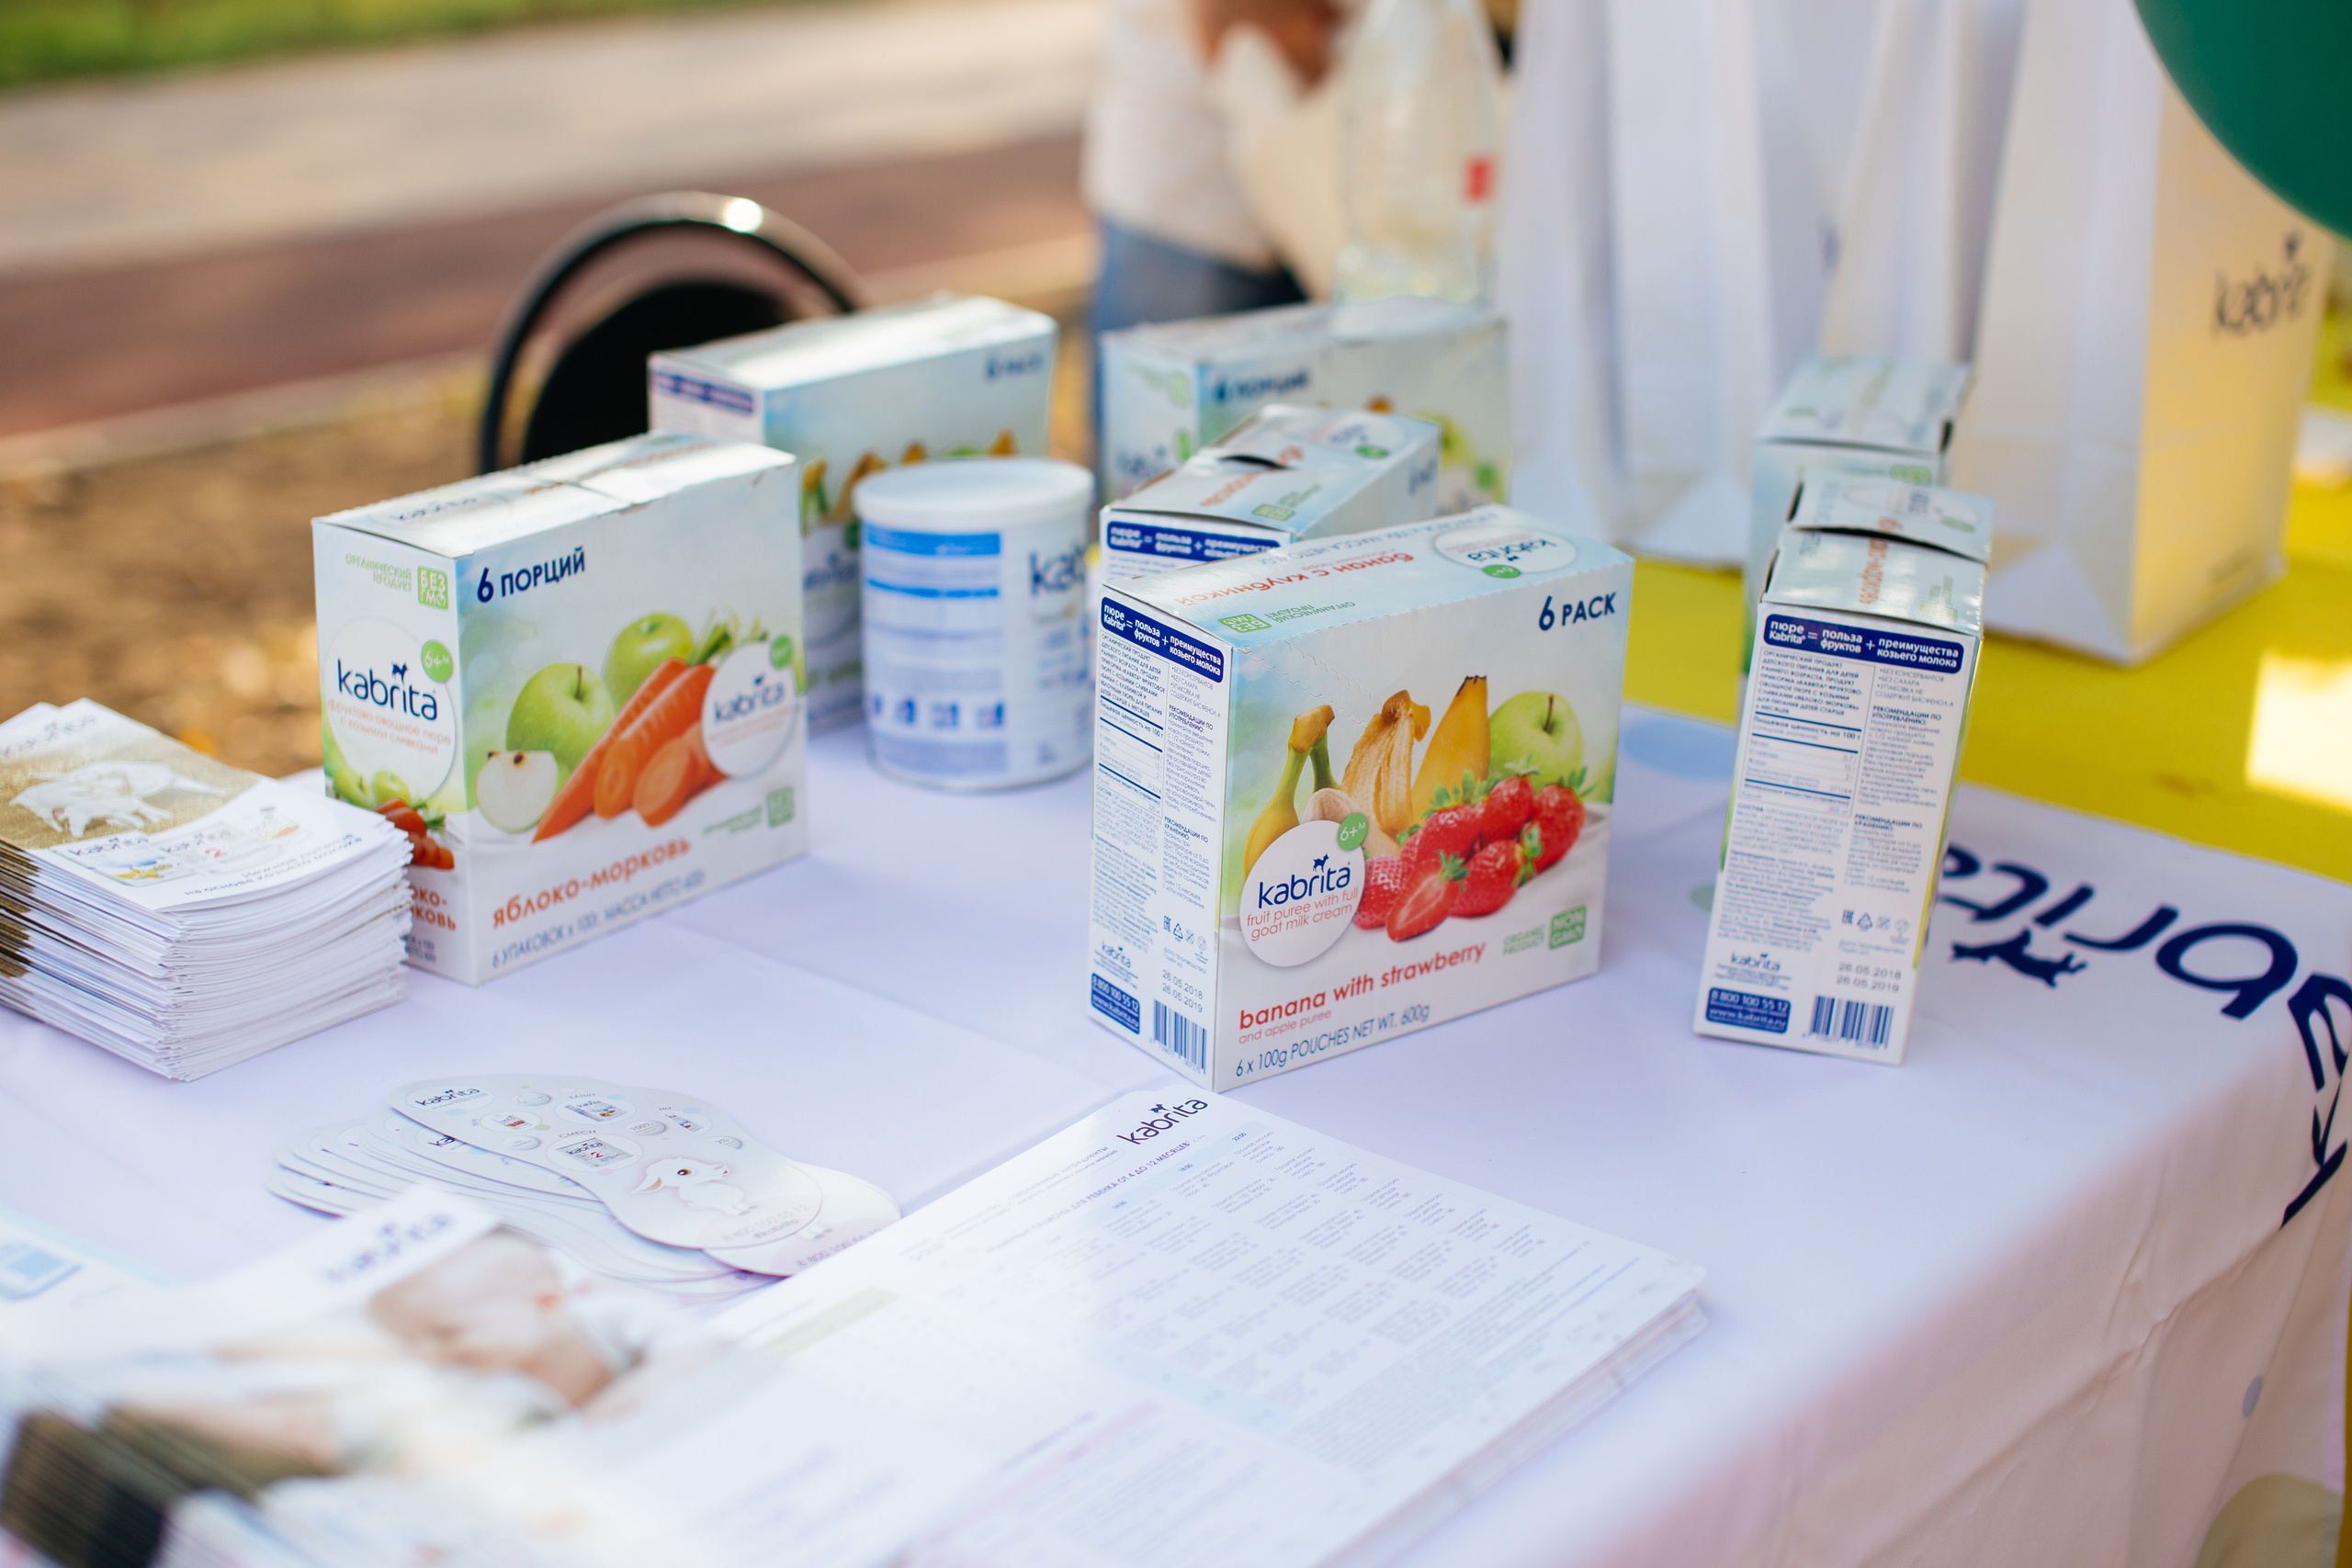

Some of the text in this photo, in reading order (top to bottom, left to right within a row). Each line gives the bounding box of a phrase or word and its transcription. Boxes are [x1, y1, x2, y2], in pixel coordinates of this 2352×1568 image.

[2209, 263, 2308, 344] kabrit
[345, 553, 412, 581] ОРГАНИЧЕСКИЙ
[477, 546, 586, 603] 6 ПОРЦИЙ
[1311, 569, 1329, 578] с
[1335, 552, 1415, 573] банан
[373, 572, 412, 592] ПРОДУКТ
[420, 569, 447, 592] БЕЗ
[1173, 573, 1310, 606] клубникой
[420, 590, 447, 607] ГМО
[1265, 604, 1315, 619] ПРОДУКТ
[1273, 602, 1356, 623] ОРГАНИЧЕСКИЙ
[1539, 592, 1616, 631] 6 PACK
[1223, 615, 1259, 626] ГМО
[1231, 618, 1270, 632] БЕЗ
[1102, 634, 1149, 662] ОРГАНИЧЕСКИЙ ПРОДУКТ
[1104, 604, 1220, 668] пюре польза преимущества
[1770, 620, 1959, 660] пюре польза преимущества
[1102, 641, 1120, 655] ДЕТСКОГО
[1122, 650, 1138, 664] ПИТАНИЯ
[1148, 664, 1160, 675] ДЕТЕЙ
[1134, 628, 1220, 676] фруктов козьего молока
[1763, 649, 1842, 669] ОРГАНИЧЕСКИЙ ПРОДУКТ
[1819, 638, 1957, 668] фруктов козьего молока
[1182, 669, 1213, 691] КОНСЕРВАНТОВ
[1796, 663, 1825, 673] ПИТАНИЯ
[337, 659, 437, 721] kabrita
[1172, 682, 1200, 701] УПАКОВКА НЕ
[1182, 678, 1197, 691] САХАРА
[715, 682, 785, 725] kabrita
[1169, 704, 1213, 730] РЕКОМЕНДАЦИИ ПО
[1170, 689, 1192, 705] СОДЕРЖИТ
[1193, 699, 1216, 717] БИСФЕНОЛ
[1872, 704, 1929, 719] РЕКОМЕНДАЦИИ
[1164, 816, 1208, 844] РЕКОМЕНДАЦИИ ПО
[410, 885, 448, 908] око-
[492, 838, 691, 929] яблоко-морковь
[1259, 865, 1351, 908] kabrita
[411, 906, 457, 932] ковь
[1247, 887, 1359, 928] fruit puree with full
[1553, 908, 1584, 931] NON
[1250, 903, 1353, 942] goat milk cream
[1503, 924, 1545, 945] ORGANIC
[501, 924, 567, 964] УПАКОВОК
[1102, 940, 1130, 969] kabrita
[1502, 935, 1544, 956] PRODUCT
[1730, 952, 1781, 972] kabrita
[1838, 961, 1902, 980] 26.05.2018
[1097, 978, 1109, 995] 800
[1110, 986, 1121, 1001] 100
[1122, 993, 1130, 1008] 55
[1132, 999, 1138, 1012] 12
[1161, 982, 1203, 1013] 26.05.2019
[1162, 968, 1203, 1000] 26.05.2018
[1238, 942, 1487, 1030] banana with strawberry
[1836, 974, 1899, 993] 26.05.2019
[1711, 989, 1788, 1012] 8 800 100 55 12
[1238, 1010, 1332, 1045] and apple puree
[1709, 1005, 1786, 1027] www.kabrita.ru
[1236, 1004, 1430, 1077] 6 x 100g POUCHES NET WT. 600g
[415, 1088, 481, 1106] kabrita
[1116, 1099, 1208, 1145] kabrita
